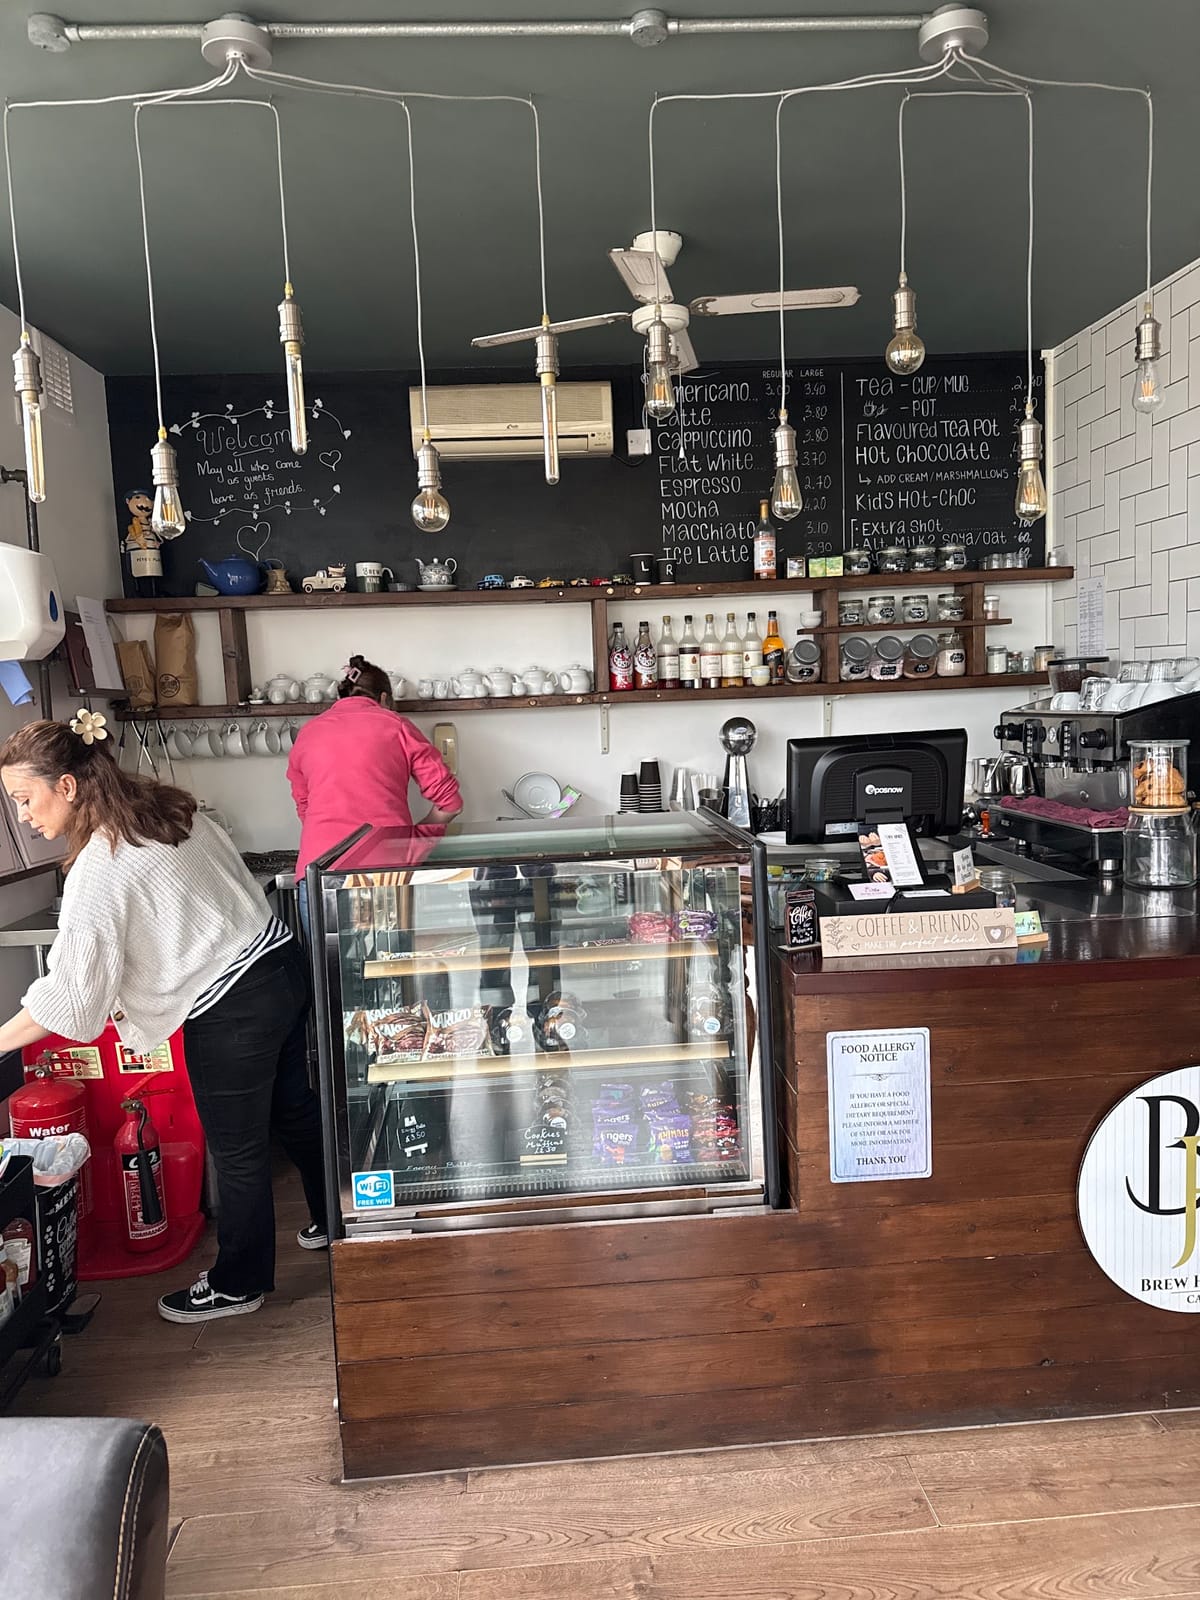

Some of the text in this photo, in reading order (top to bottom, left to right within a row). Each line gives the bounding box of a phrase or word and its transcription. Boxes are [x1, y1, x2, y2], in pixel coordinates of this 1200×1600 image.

[800, 369, 824, 377] LARGE
[671, 382, 750, 403] mericano
[856, 378, 893, 396] Tea
[912, 398, 937, 417] POT
[856, 421, 938, 442] Flavoured
[940, 418, 970, 438] Tea
[196, 424, 300, 456] Welcom
[657, 428, 752, 451] Cappuccino
[855, 446, 890, 465] Hot
[896, 441, 991, 464] Chocolate
[197, 458, 302, 483] May all who come
[659, 455, 702, 474] Flat
[707, 451, 753, 471] White
[227, 472, 275, 491] as guests
[877, 473, 895, 484] ADD
[899, 469, 1009, 483] CREAM/MARSHMALLOWS
[660, 475, 741, 497] Espresso
[243, 491, 258, 500] as
[661, 500, 719, 520] Mocha
[662, 521, 756, 543] Macchiato
[862, 520, 906, 536] Extra
[910, 519, 944, 533] Shot
[697, 544, 750, 564] Latte
[666, 564, 674, 575] R
[856, 912, 980, 938] COFFEE & FRIENDS
[841, 1042, 916, 1054] FOOD ALLERGY
[860, 1053, 898, 1063] NOTICE
[29, 1122, 70, 1137] Water
[524, 1128, 560, 1140] Cookies
[526, 1140, 563, 1149] Muffins
[869, 1138, 912, 1146] INFORMATION
[129, 1151, 158, 1169] C2
[856, 1155, 906, 1166] THANK YOU
[1141, 1277, 1188, 1292] BREW
